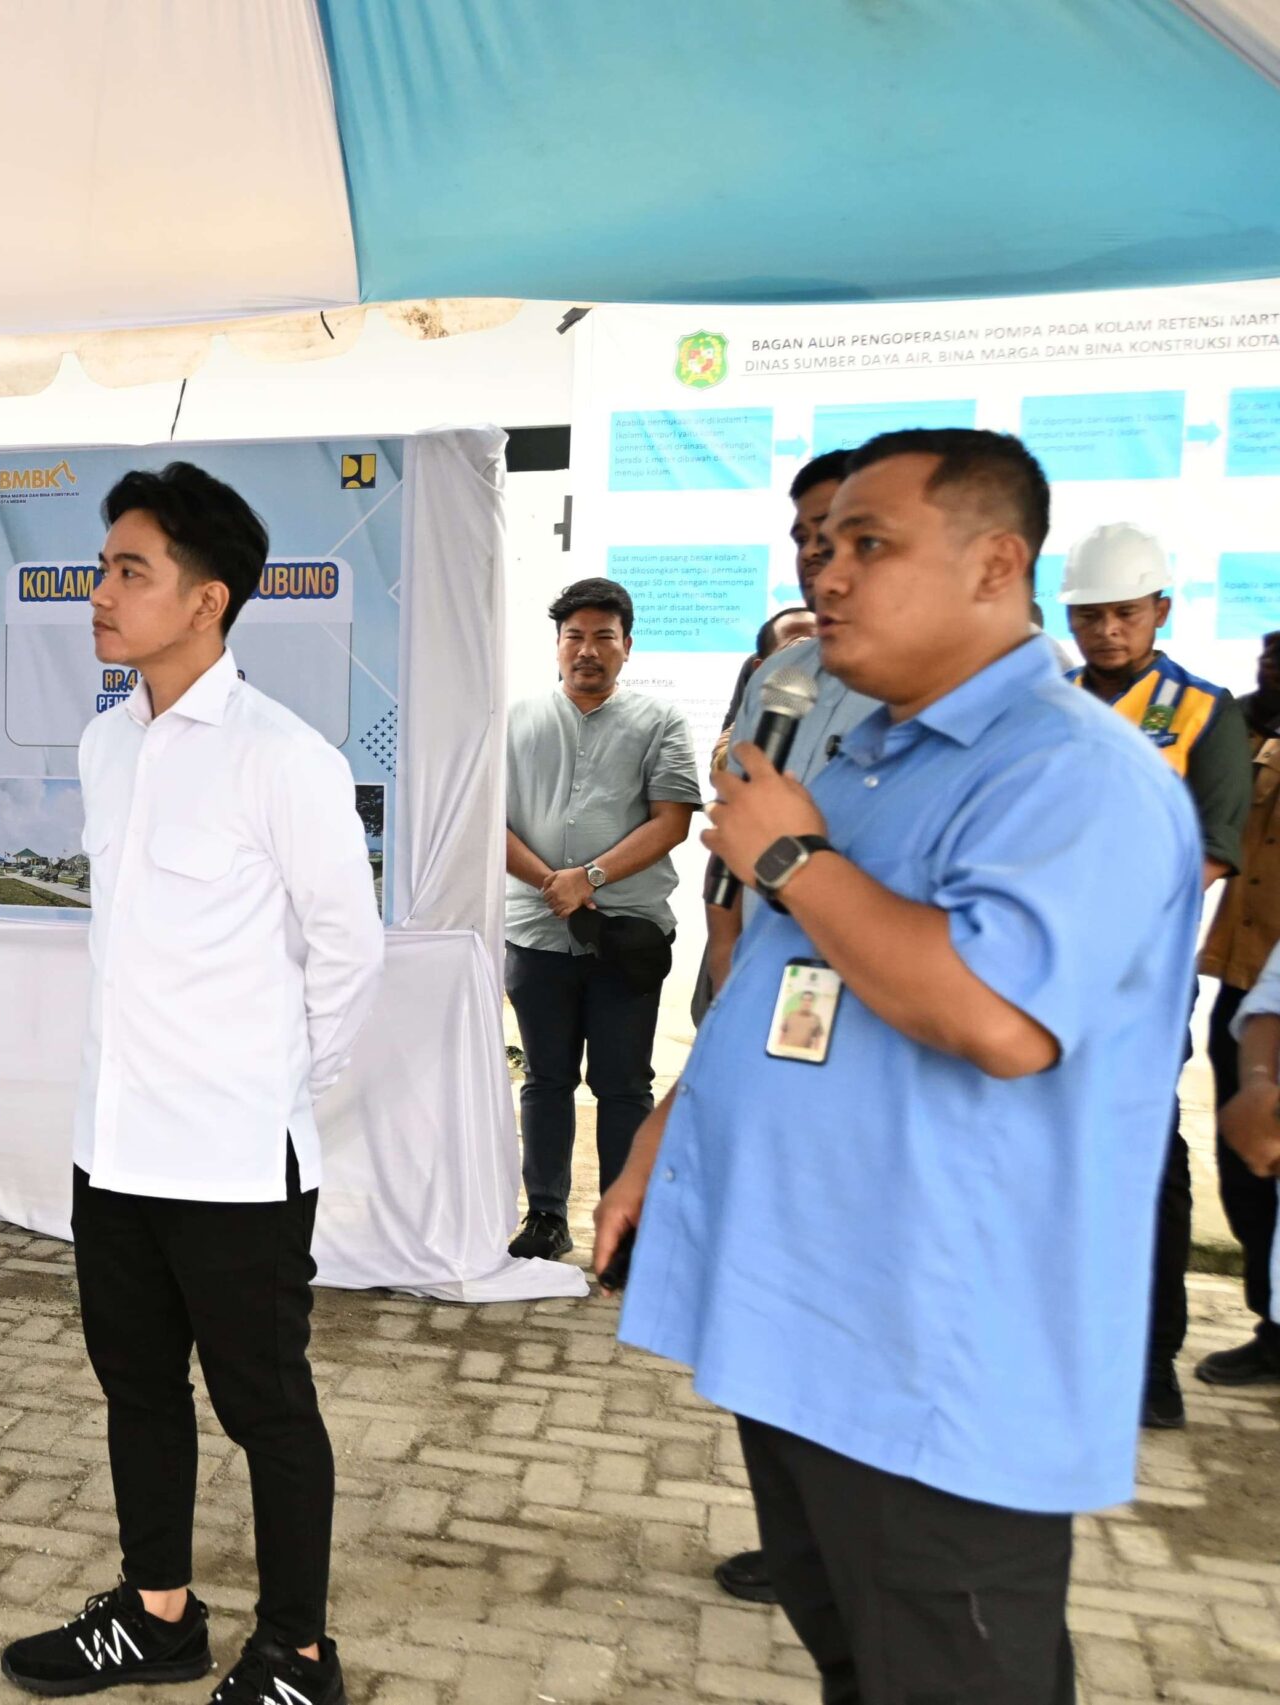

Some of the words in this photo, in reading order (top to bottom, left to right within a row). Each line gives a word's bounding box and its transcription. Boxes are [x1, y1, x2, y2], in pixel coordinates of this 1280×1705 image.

[751, 337, 803, 351] BAGAN
[807, 335, 846, 348] ALUR
[850, 328, 979, 347] PENGOPERASIAN
[984, 325, 1042, 340] POMPA
[1048, 322, 1089, 336] PADA
[1094, 318, 1152, 333] KOLAM
[1157, 315, 1224, 331] RETENSI
[744, 358, 789, 372] DINAS
[793, 355, 856, 370] SUMBER
[861, 352, 900, 366] DAYA
[905, 350, 932, 364] AIR,
[938, 349, 975, 362] BINA
[980, 346, 1039, 360] MARGA
[1045, 344, 1079, 358] DAN
[1085, 341, 1124, 356] BINA
[1129, 336, 1231, 353] KONSTRUKSI
[1237, 334, 1280, 348] KOTA
[612, 555, 629, 563] Saat
[631, 555, 658, 563] musim
[659, 554, 687, 565] pasang
[714, 553, 739, 562] kolam
[612, 567, 628, 575] bisa
[629, 567, 679, 577] dikosongkan
[21, 569, 95, 600] KOLAM
[656, 591, 681, 600] untuk
[669, 603, 695, 612] disaat
[638, 616, 661, 626] hujan
[662, 616, 677, 624] dan
[679, 616, 709, 626] pasang
